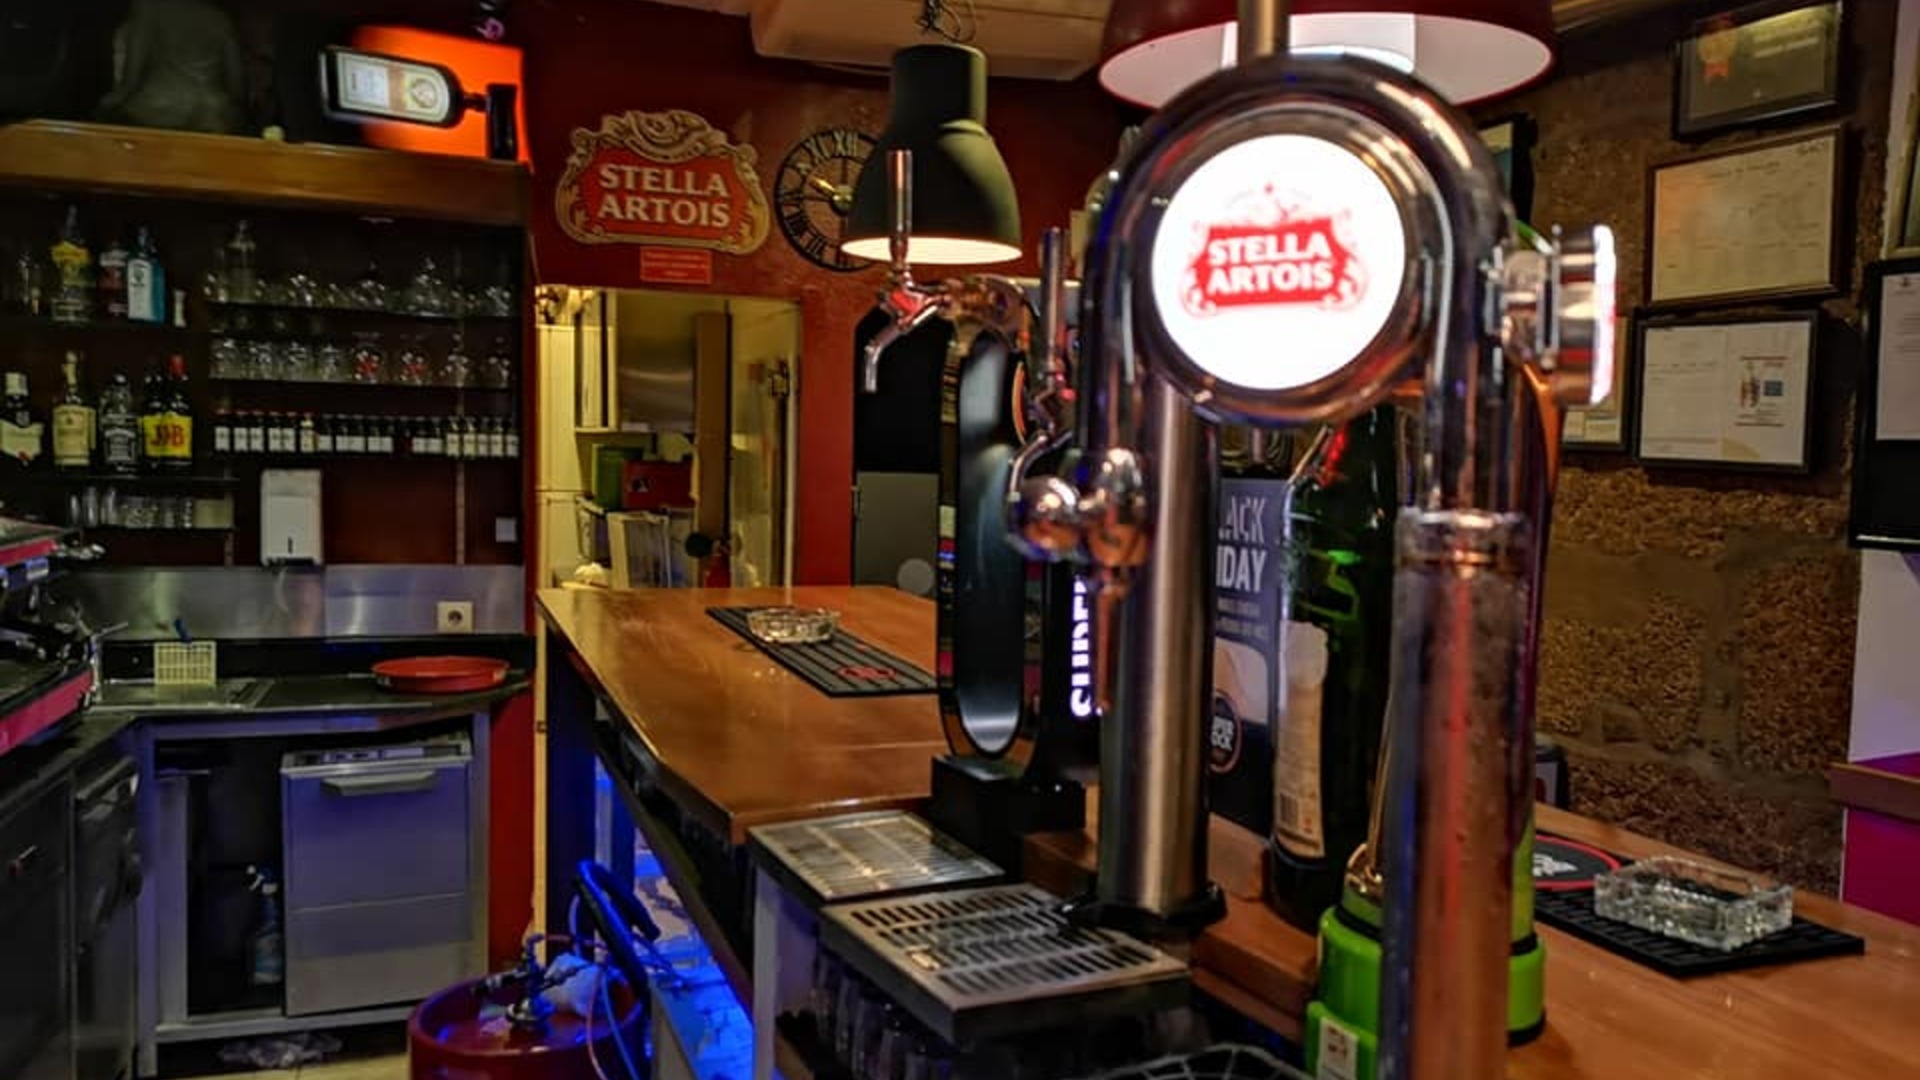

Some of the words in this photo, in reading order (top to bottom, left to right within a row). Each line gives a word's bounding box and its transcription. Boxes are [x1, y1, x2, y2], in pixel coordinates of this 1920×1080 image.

[600, 163, 729, 198] STELLA
[600, 193, 731, 228] ARTOIS
[1208, 232, 1332, 265] STELLA
[1206, 262, 1335, 295] ARTOIS
[1219, 497, 1266, 543] ACK
